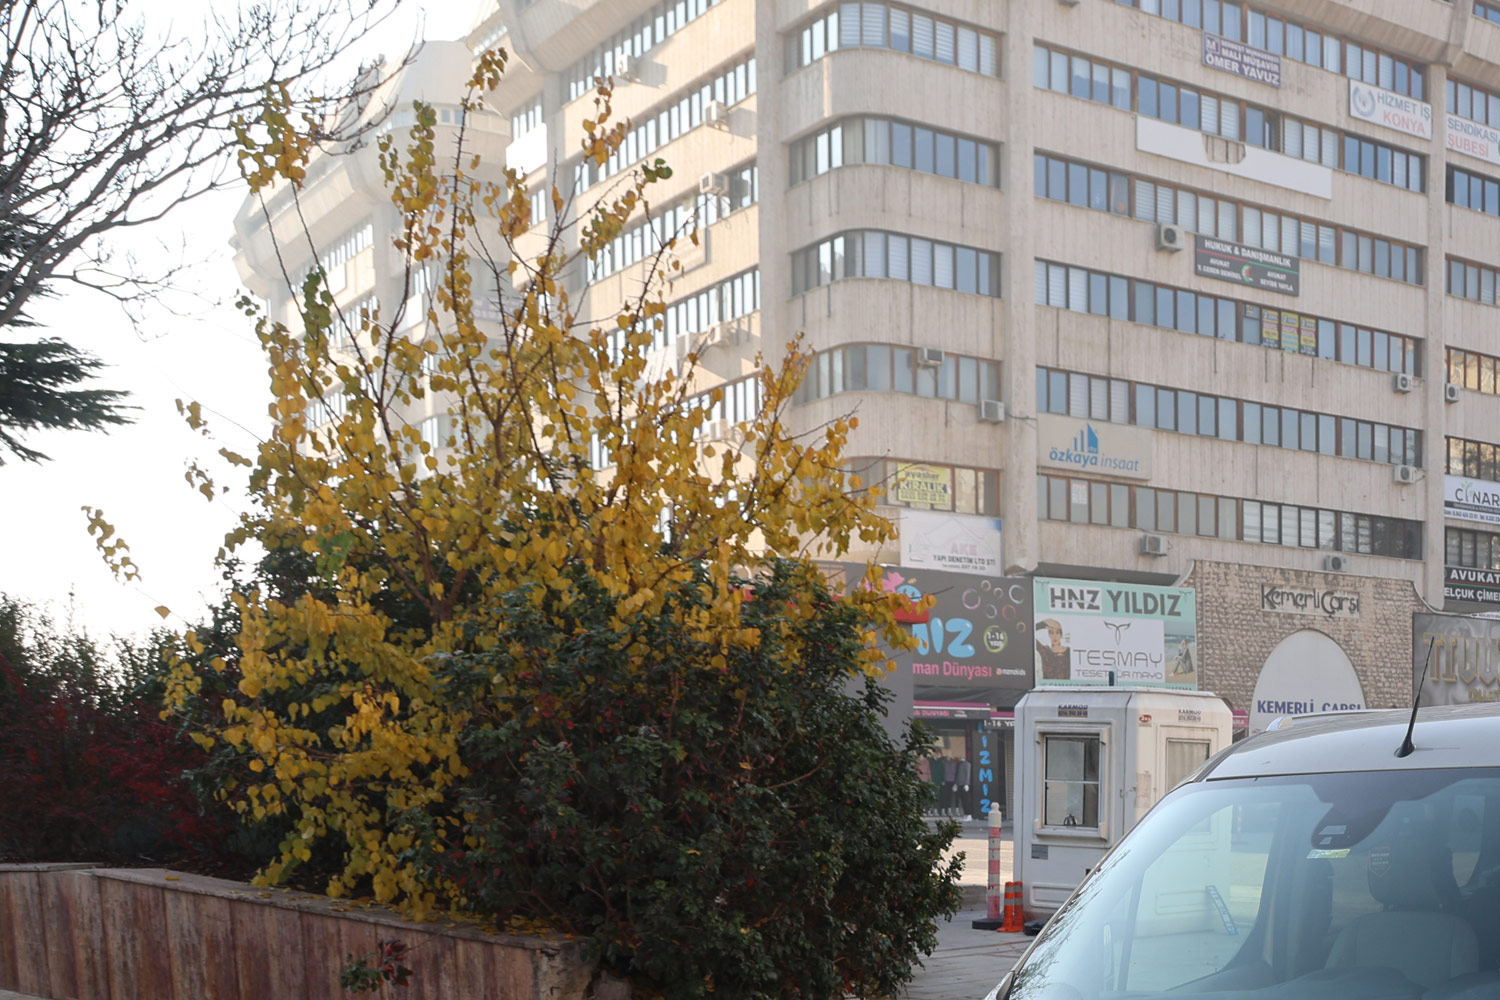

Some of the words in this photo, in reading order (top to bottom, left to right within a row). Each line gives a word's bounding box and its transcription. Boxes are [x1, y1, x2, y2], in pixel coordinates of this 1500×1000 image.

[1242, 63, 1280, 84] YAVUZ
[1377, 91, 1417, 114] HİZMET
[1383, 110, 1426, 135] KONYA
[1204, 239, 1233, 254] HUKUK
[1049, 446, 1098, 468] özkaya
[1050, 587, 1100, 610] HNZ
[1106, 589, 1182, 617] YILDIZ
[1444, 587, 1475, 599] ELÇUK
[1073, 650, 1163, 668] TESMAY
[942, 660, 992, 681] Dünyası
[1131, 670, 1163, 680] MAYO
[1257, 699, 1314, 714] KEMERLİ
